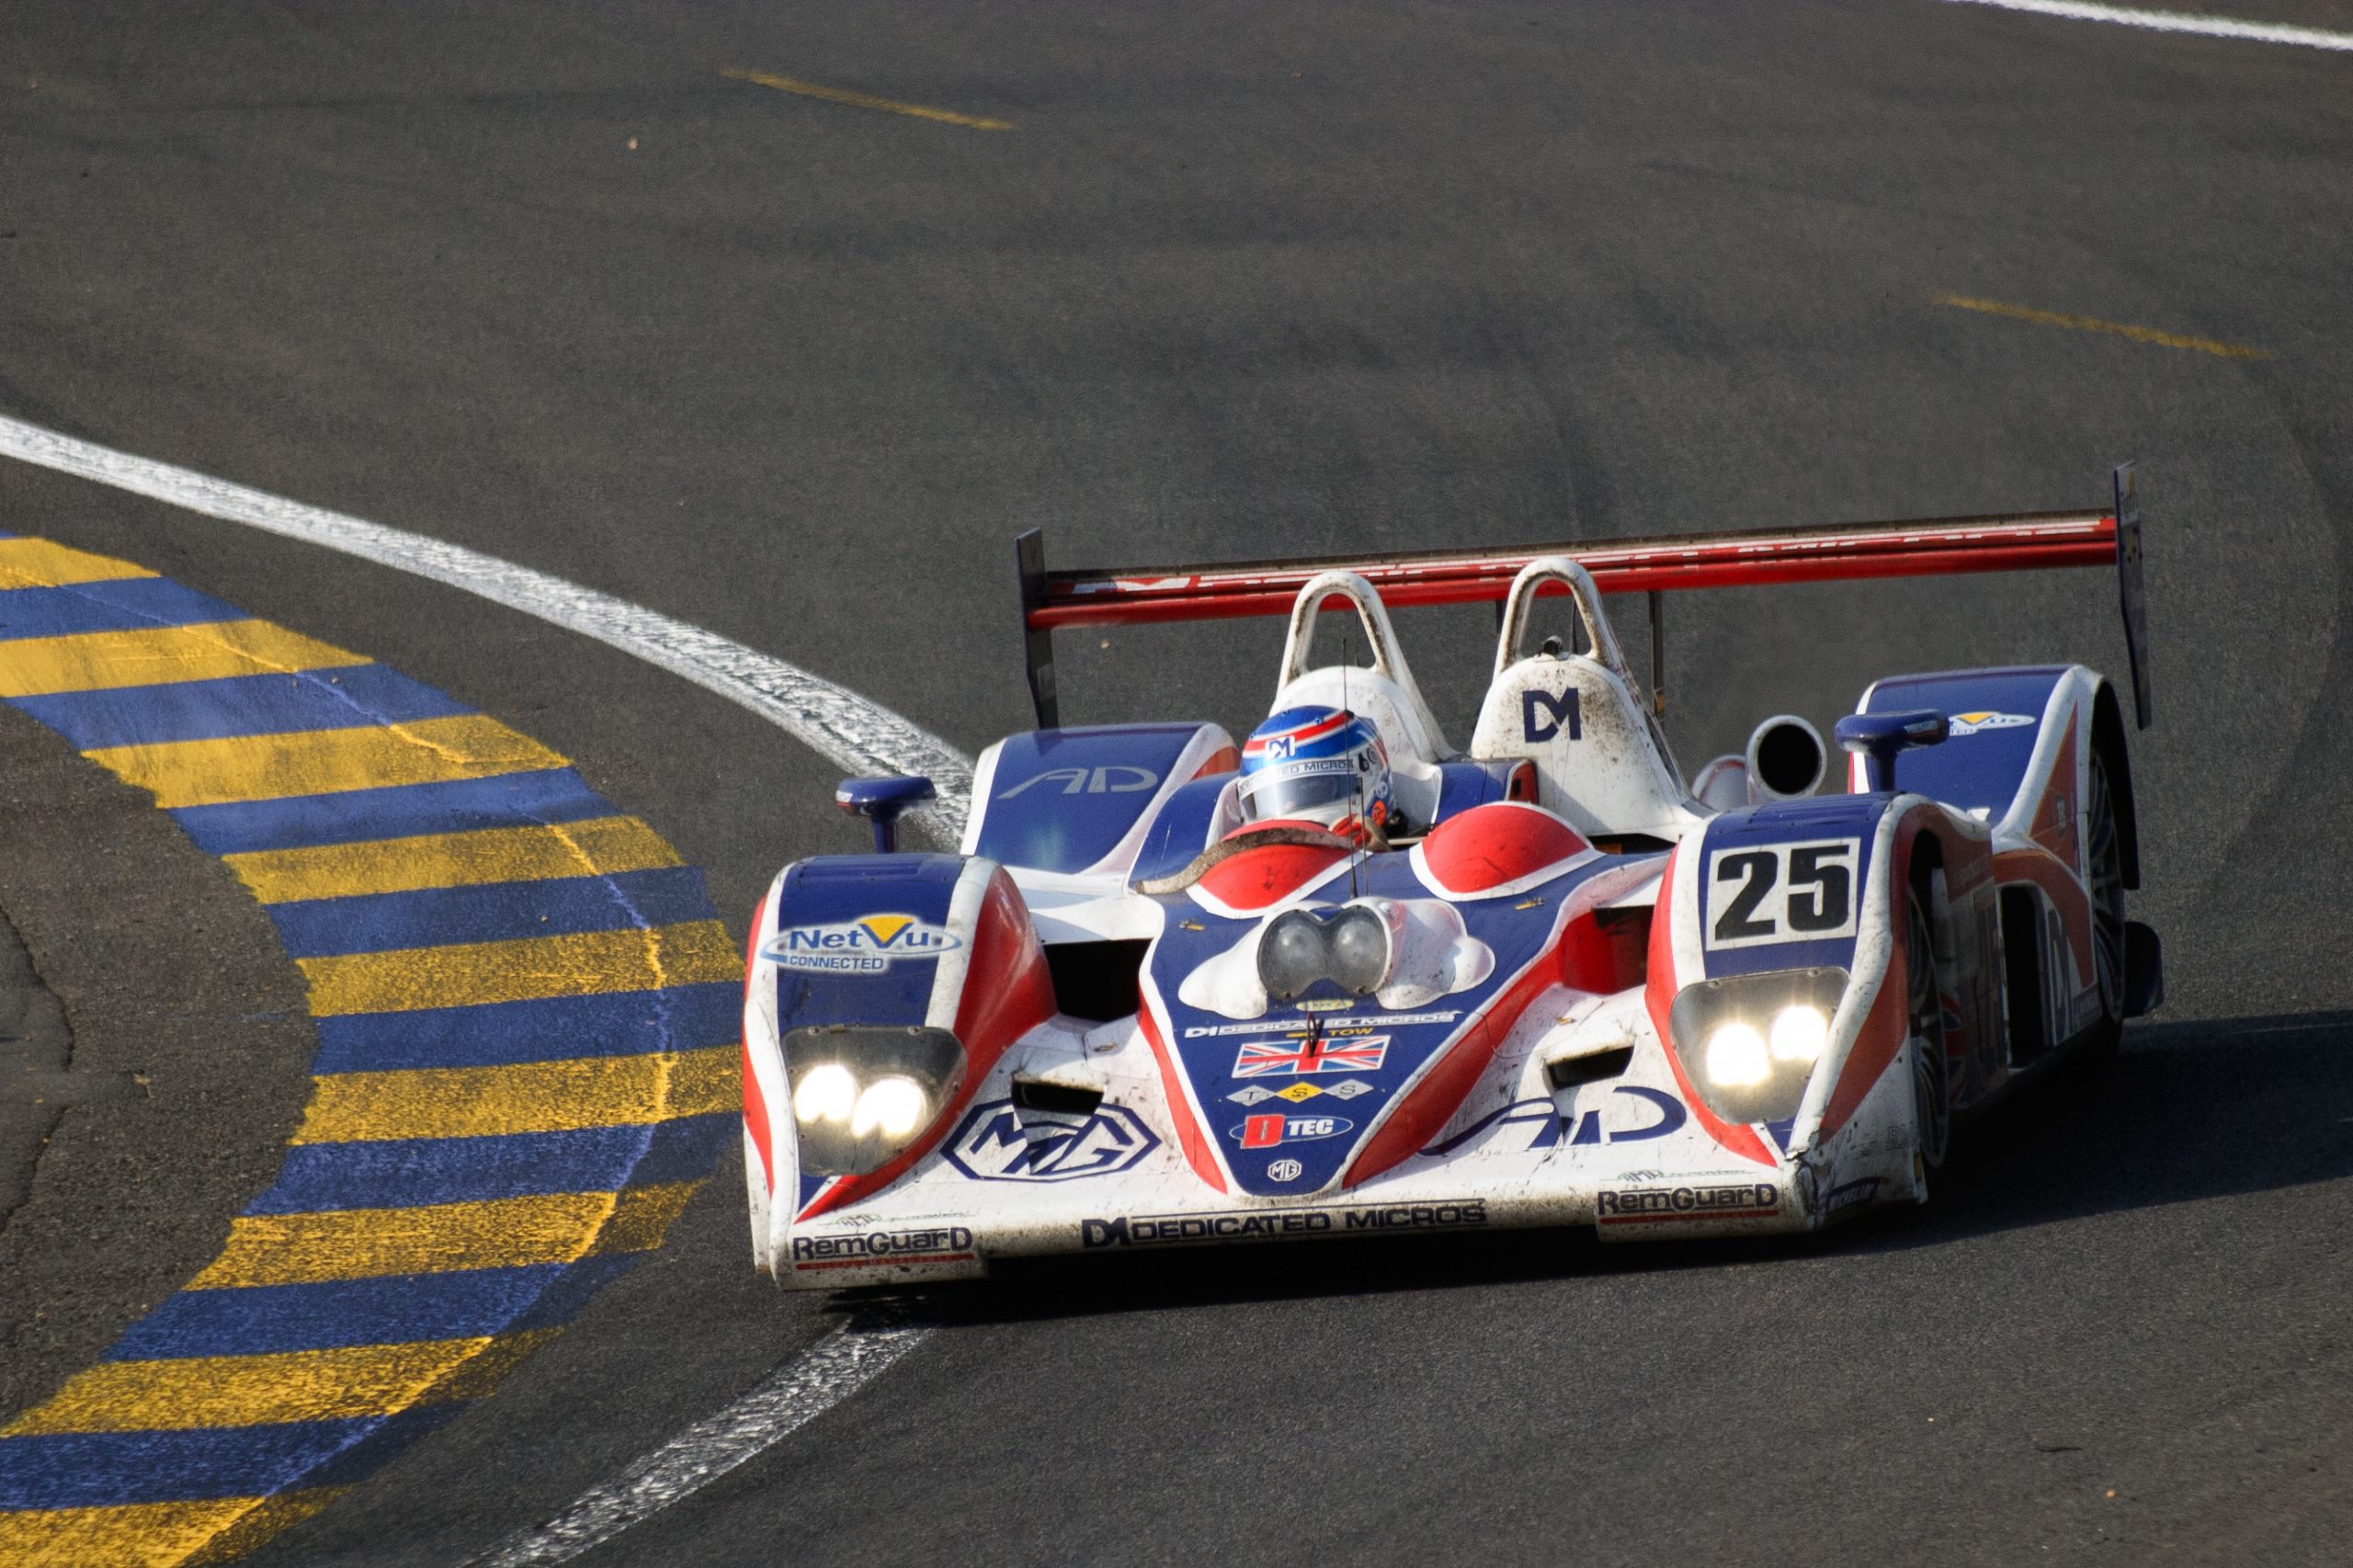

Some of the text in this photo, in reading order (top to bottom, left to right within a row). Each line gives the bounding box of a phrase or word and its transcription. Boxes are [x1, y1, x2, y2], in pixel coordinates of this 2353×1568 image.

[1522, 687, 1582, 744] DM
[1715, 845, 1850, 941] 25
[790, 919, 929, 949] NetVu
[790, 955, 884, 971] CONNECTED
[1219, 1017, 1351, 1036] DEDICAED
[1328, 1028, 1373, 1037] TOW
[1288, 1119, 1334, 1136] TEC
[965, 1106, 1140, 1177] MG
[1269, 1160, 1301, 1181] MG
[1132, 1211, 1332, 1242] DEDICATED
[1345, 1204, 1487, 1230] MICROS
